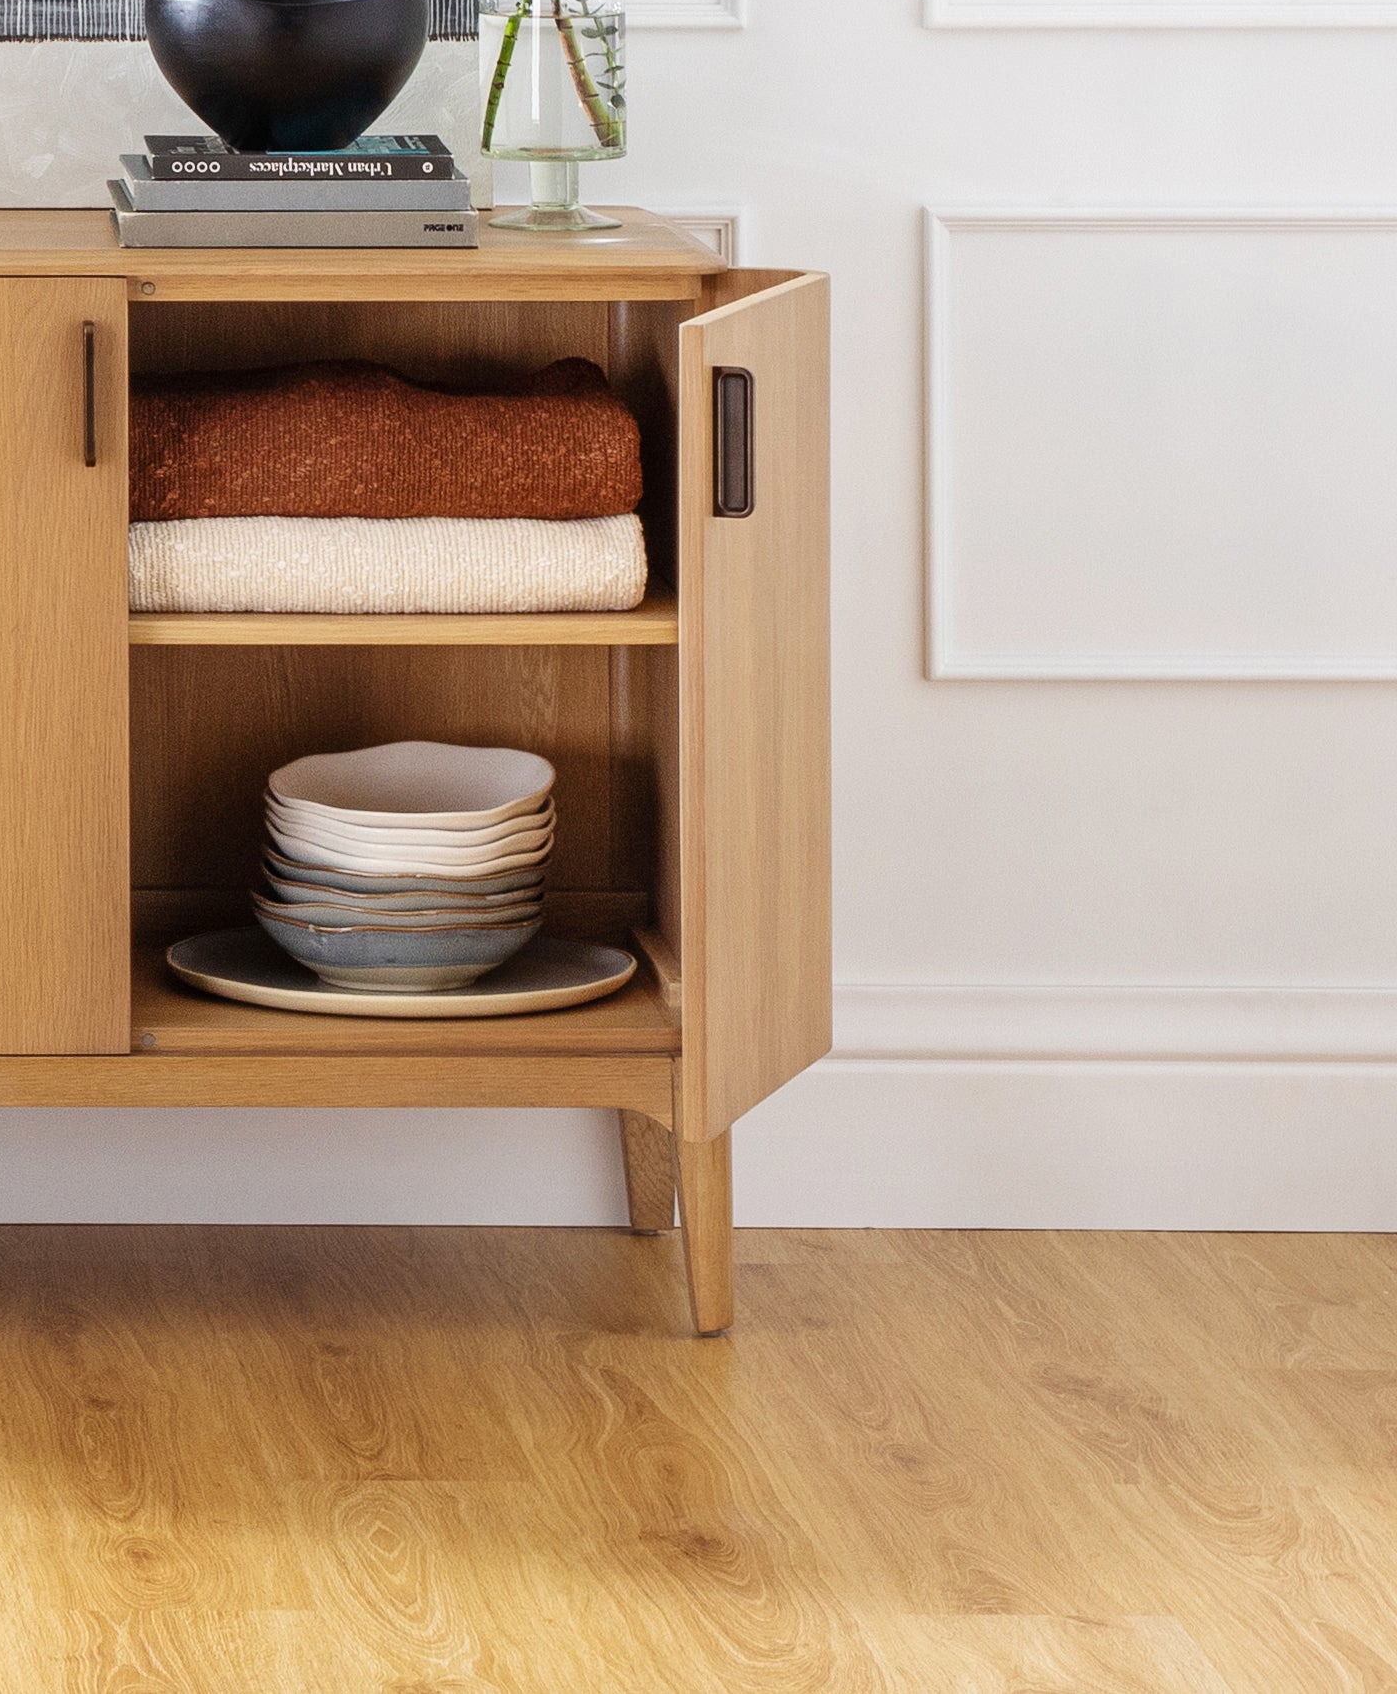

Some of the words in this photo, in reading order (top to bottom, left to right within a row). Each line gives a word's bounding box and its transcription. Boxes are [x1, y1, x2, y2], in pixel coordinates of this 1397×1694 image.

[248, 157, 344, 177] Marketplaces
[347, 161, 393, 177] Urban
[423, 224, 445, 232] PAGE
[446, 224, 464, 232] ONE
